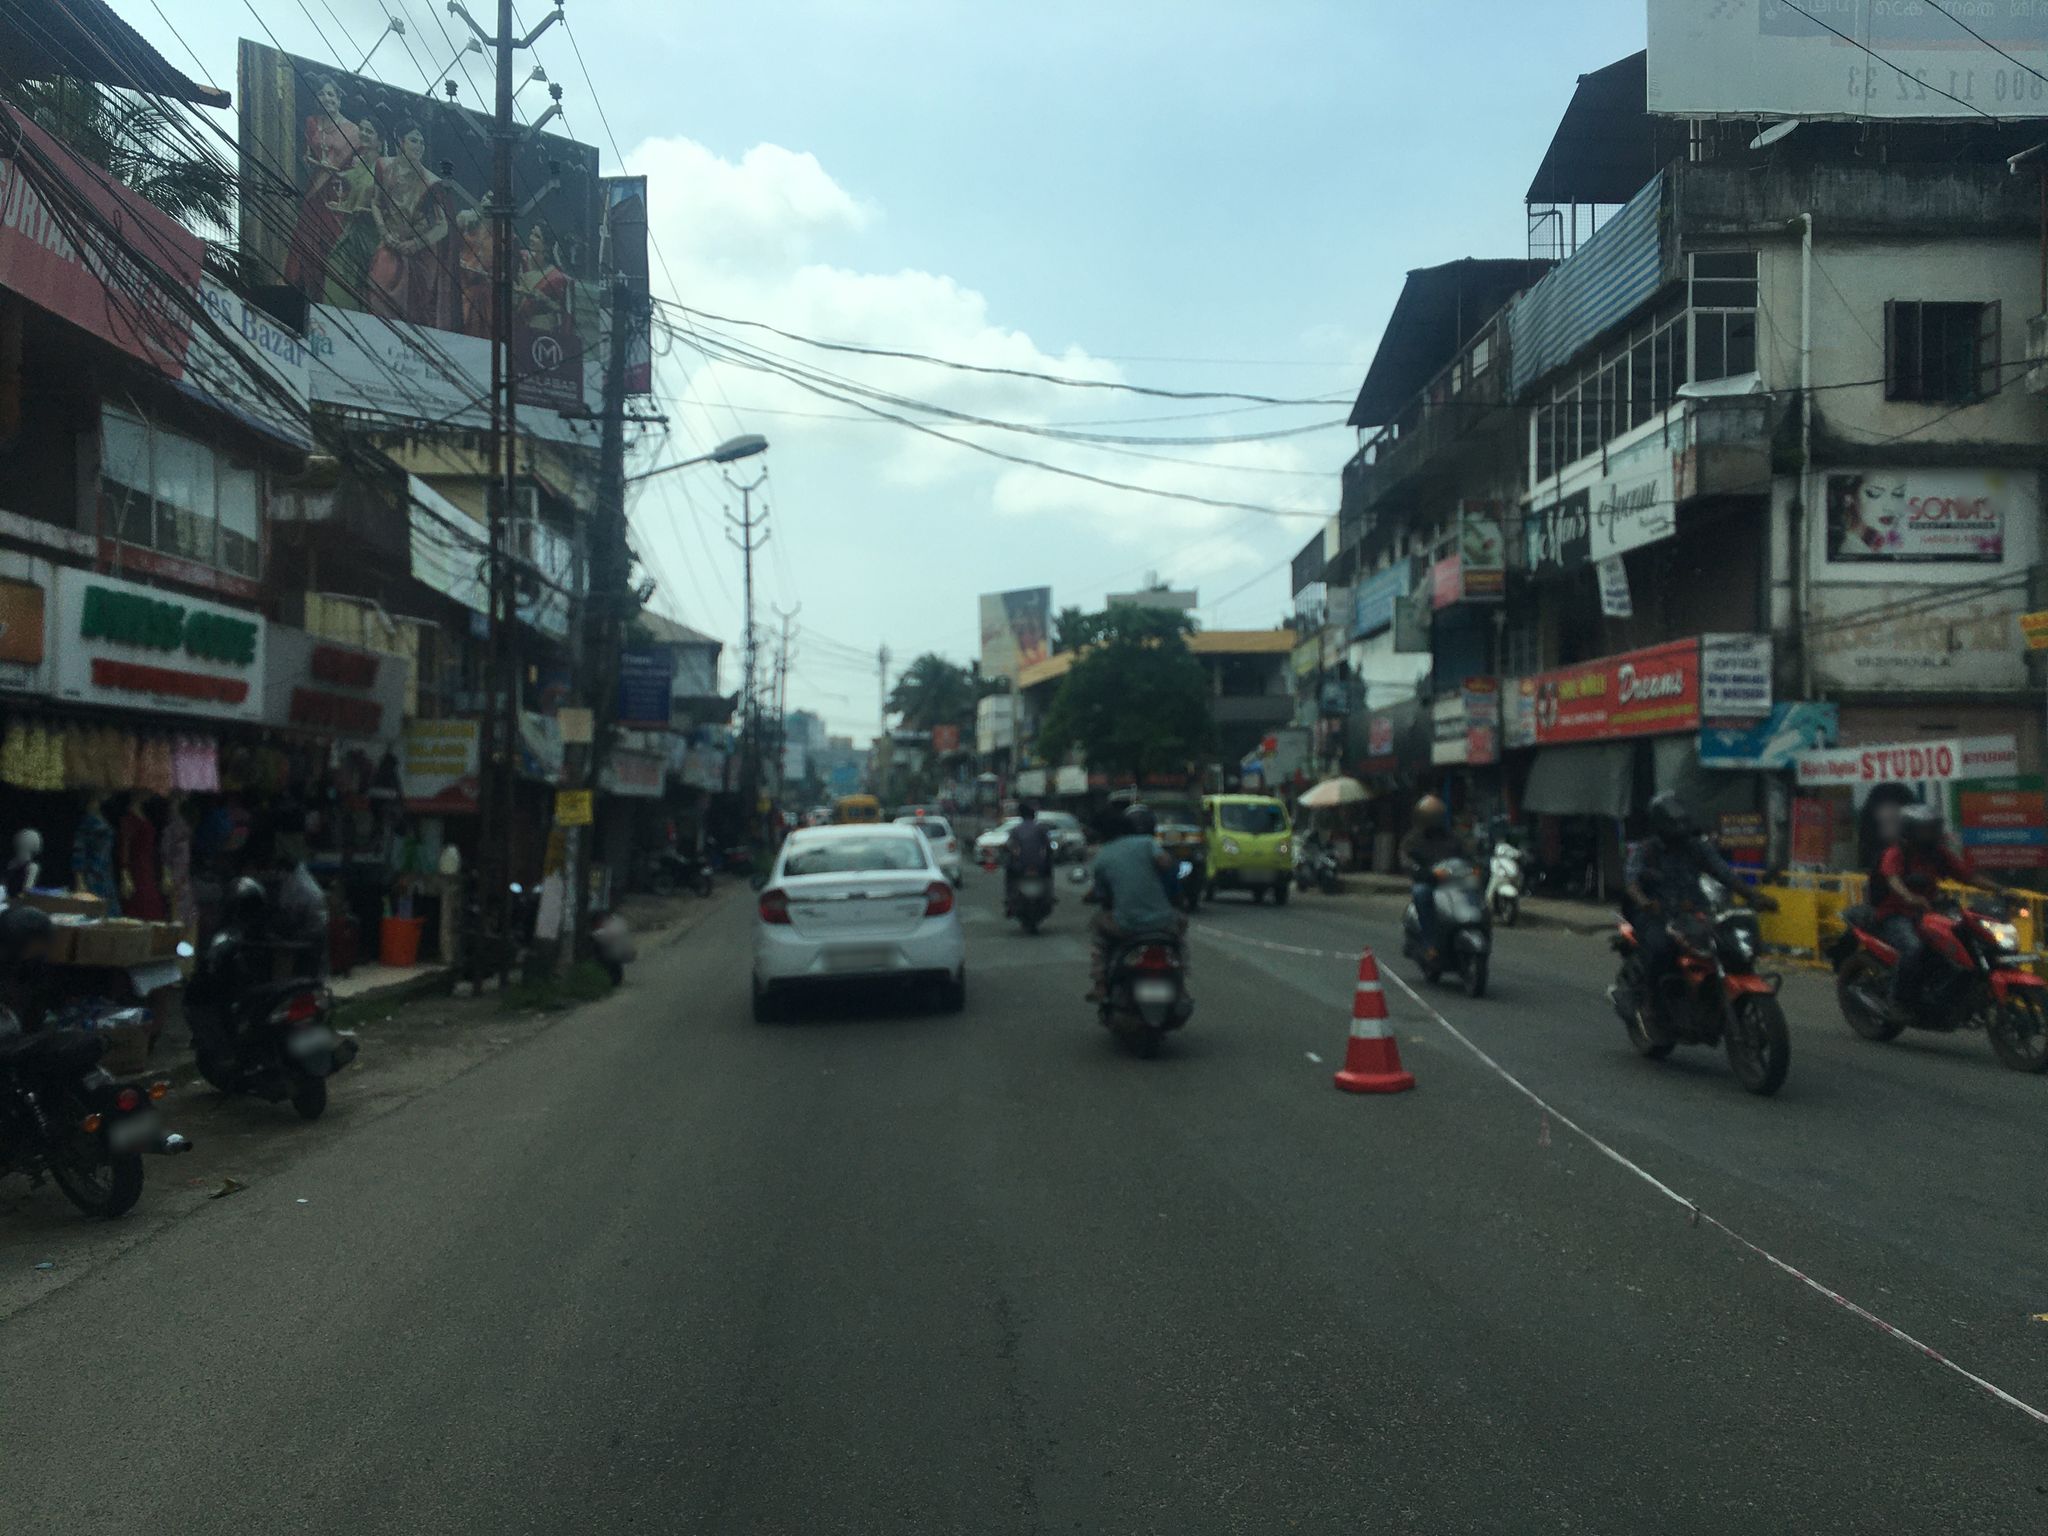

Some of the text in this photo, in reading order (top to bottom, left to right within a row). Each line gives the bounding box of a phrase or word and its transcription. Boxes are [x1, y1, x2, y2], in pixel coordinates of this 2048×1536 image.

[241, 302, 305, 368] Bazar
[1618, 663, 1684, 705] Dreams
[1860, 746, 1953, 781] STUDIO
